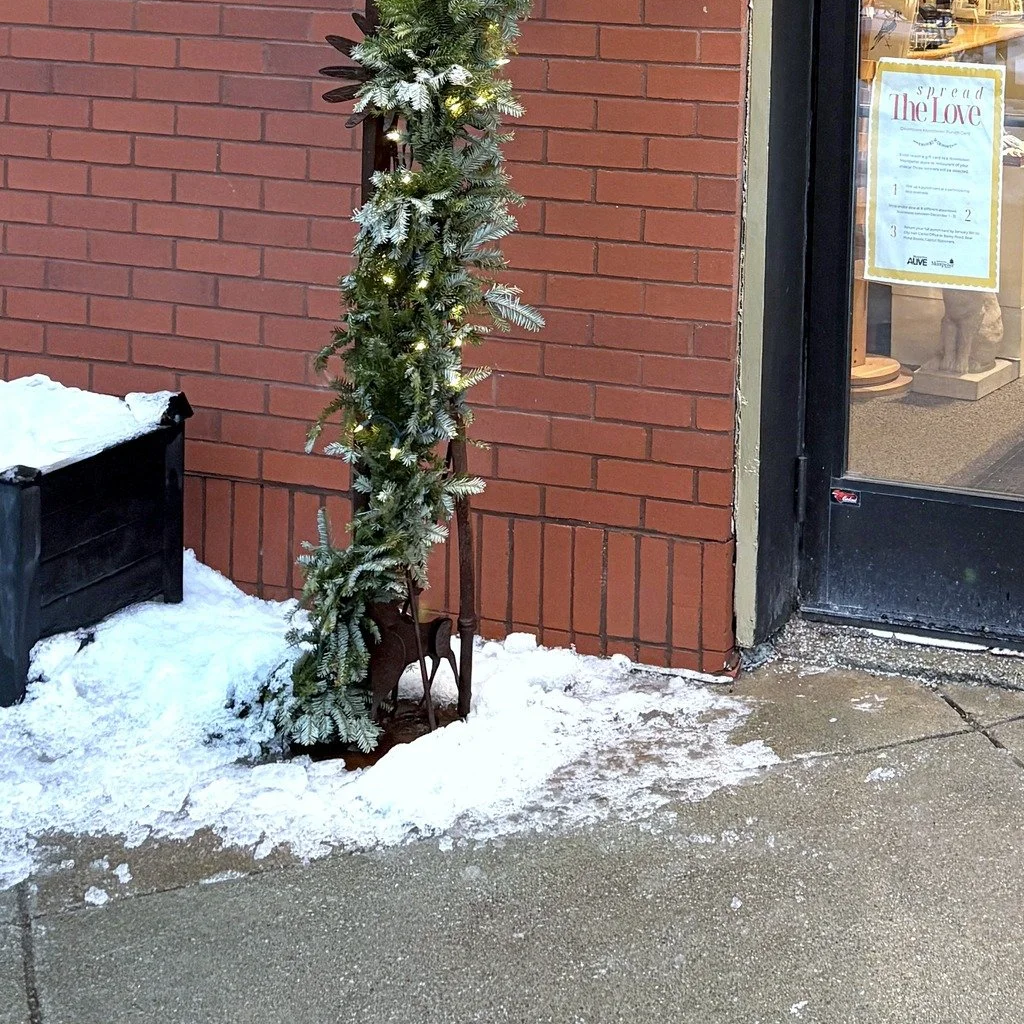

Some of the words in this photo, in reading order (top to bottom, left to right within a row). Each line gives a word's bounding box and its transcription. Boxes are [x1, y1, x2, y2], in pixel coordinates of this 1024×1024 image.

[916, 84, 984, 101] spread
[889, 92, 928, 123] The
[932, 96, 982, 127] Love
[891, 183, 898, 196] 1
[964, 208, 972, 222] 2
[890, 224, 897, 238] 3
[907, 257, 928, 267] ALIVE
